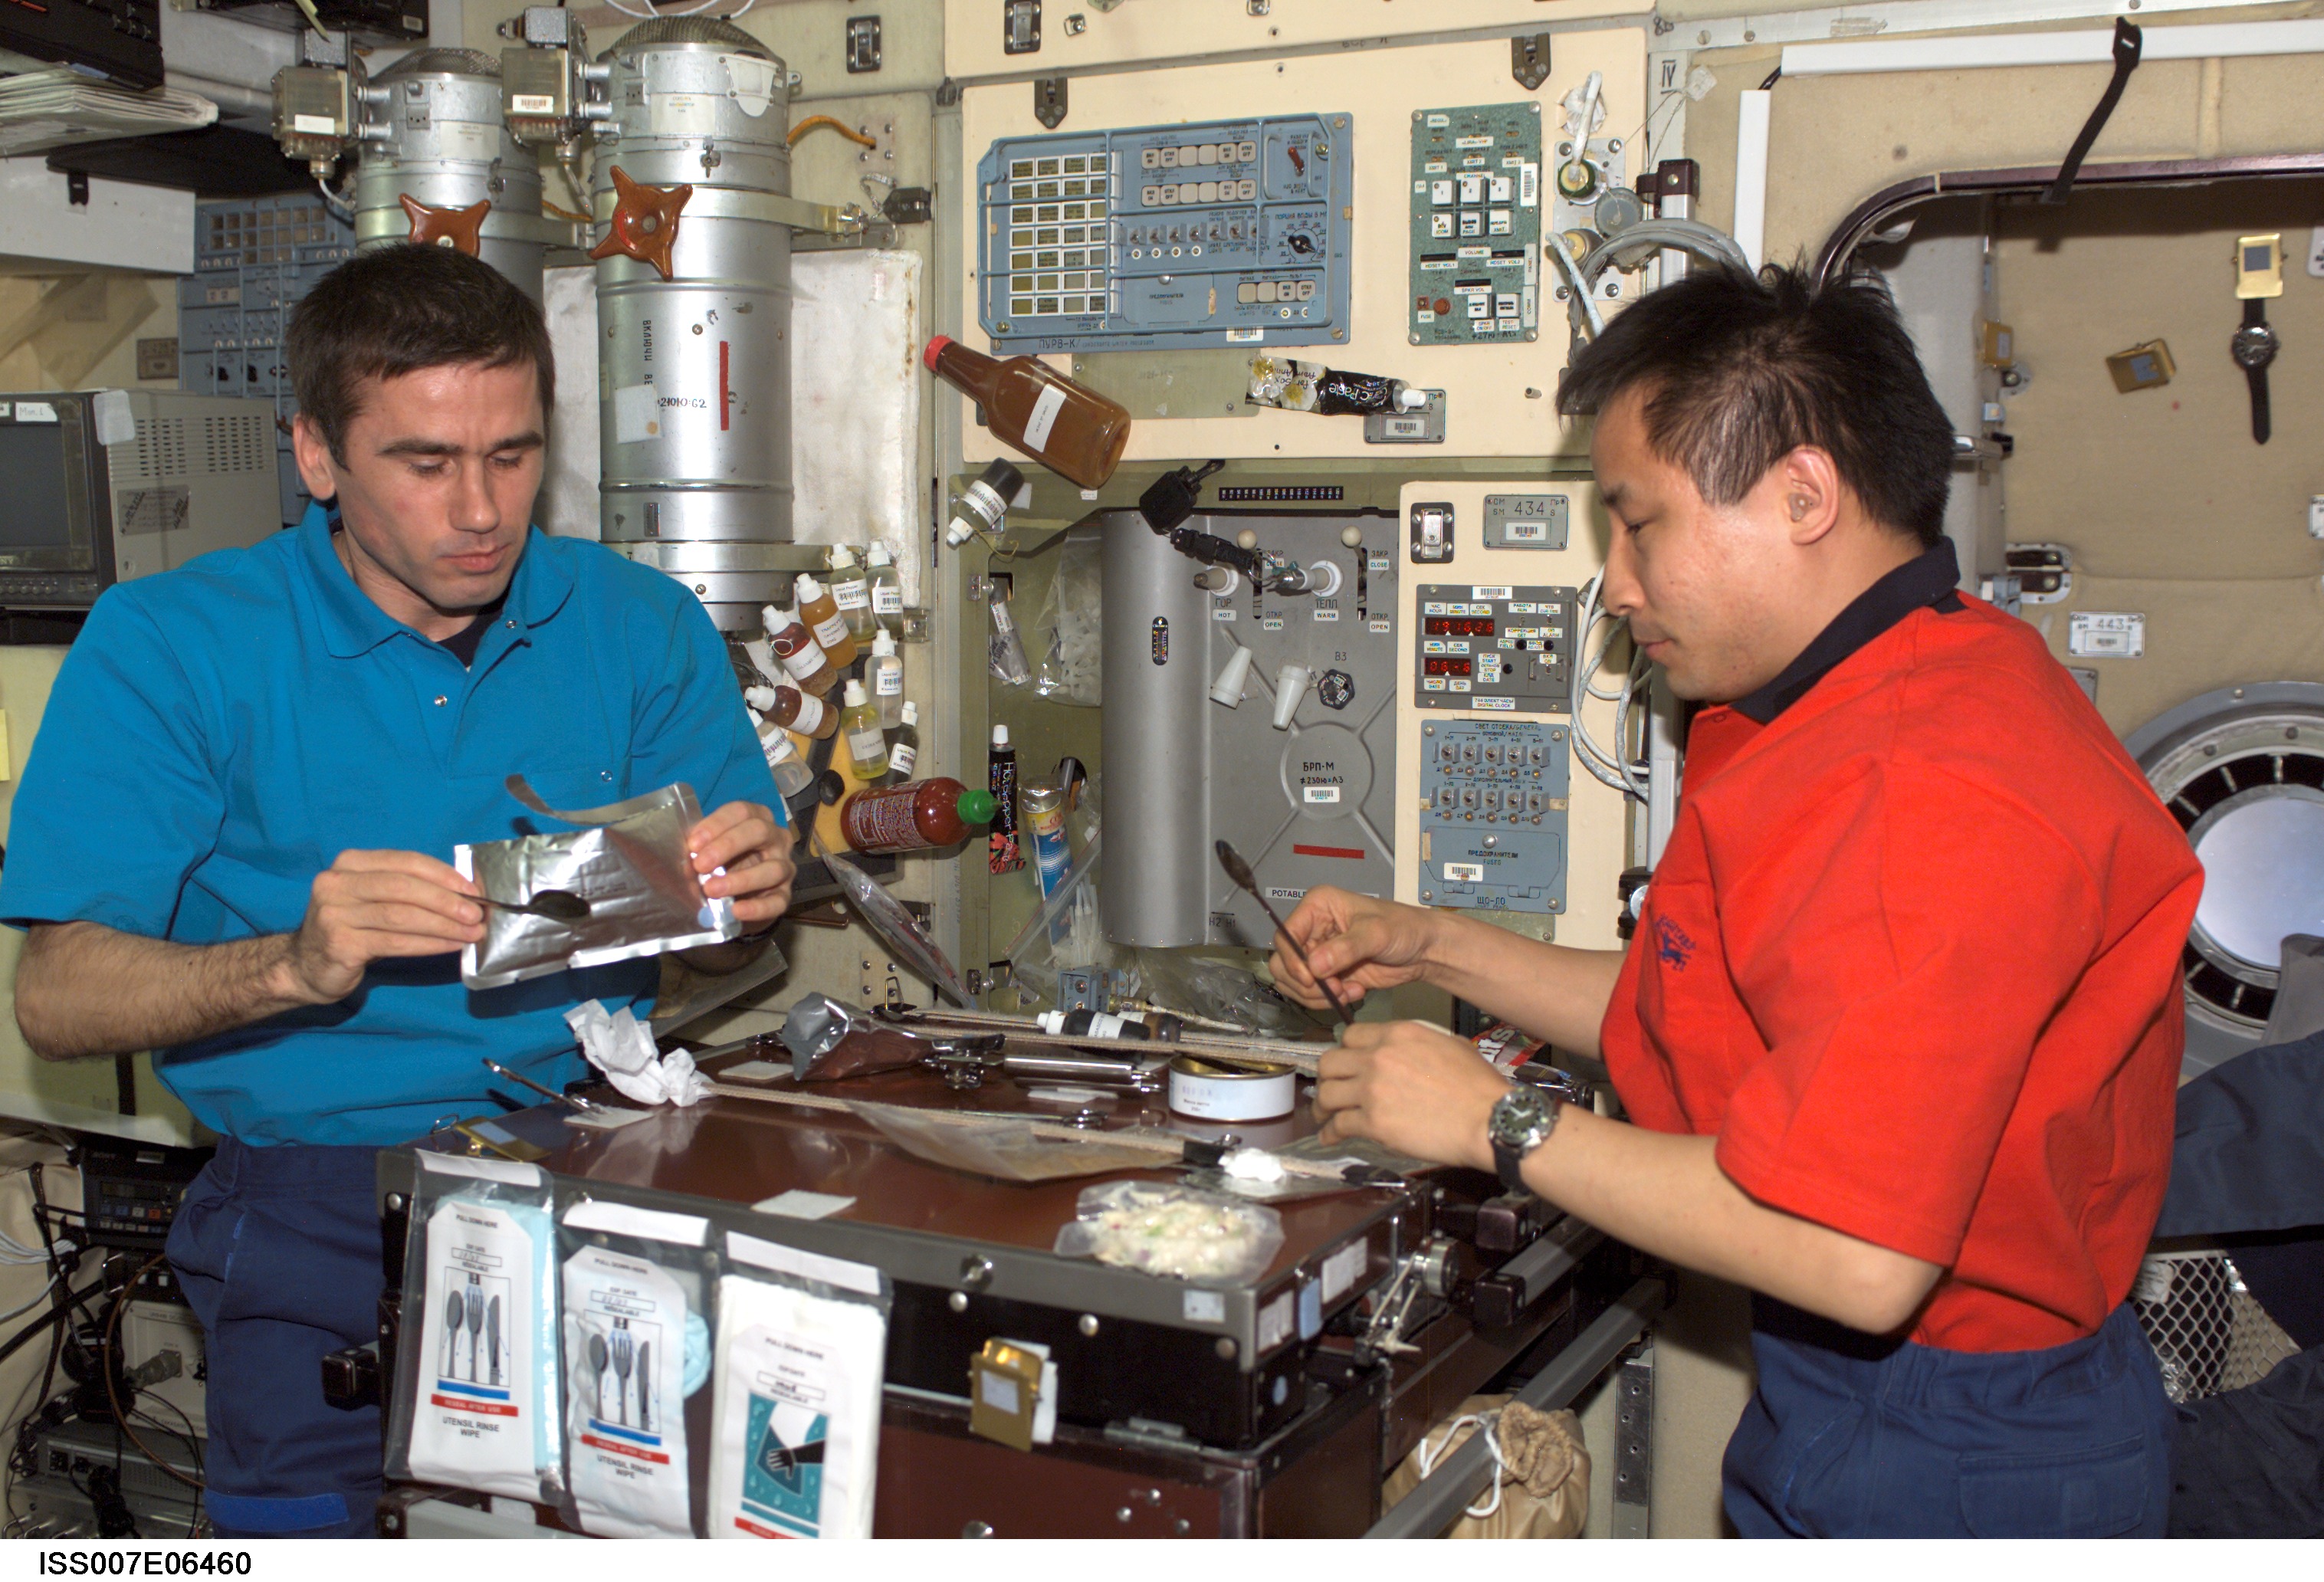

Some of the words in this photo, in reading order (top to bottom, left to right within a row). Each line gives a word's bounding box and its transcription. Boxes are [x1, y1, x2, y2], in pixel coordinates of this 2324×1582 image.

[642, 319, 652, 362] ВКЛЮЧИ
[1273, 376, 1292, 386] Sox
[1296, 379, 1309, 389] for
[1328, 382, 1359, 400] Paste
[1514, 501, 1545, 516] 434
[2097, 618, 2125, 629] 443
[1302, 761, 1334, 772] БРП-М
[1468, 849, 1518, 858] ПРЕДОХРАНИТЕЛИ
[442, 1416, 474, 1428] UTENSIL
[476, 1421, 500, 1432] RINSE
[460, 1428, 481, 1438] WIPE
[597, 1454, 629, 1469] UTENSIL
[630, 1463, 654, 1475] RINSE
[615, 1468, 635, 1479] WIPE
